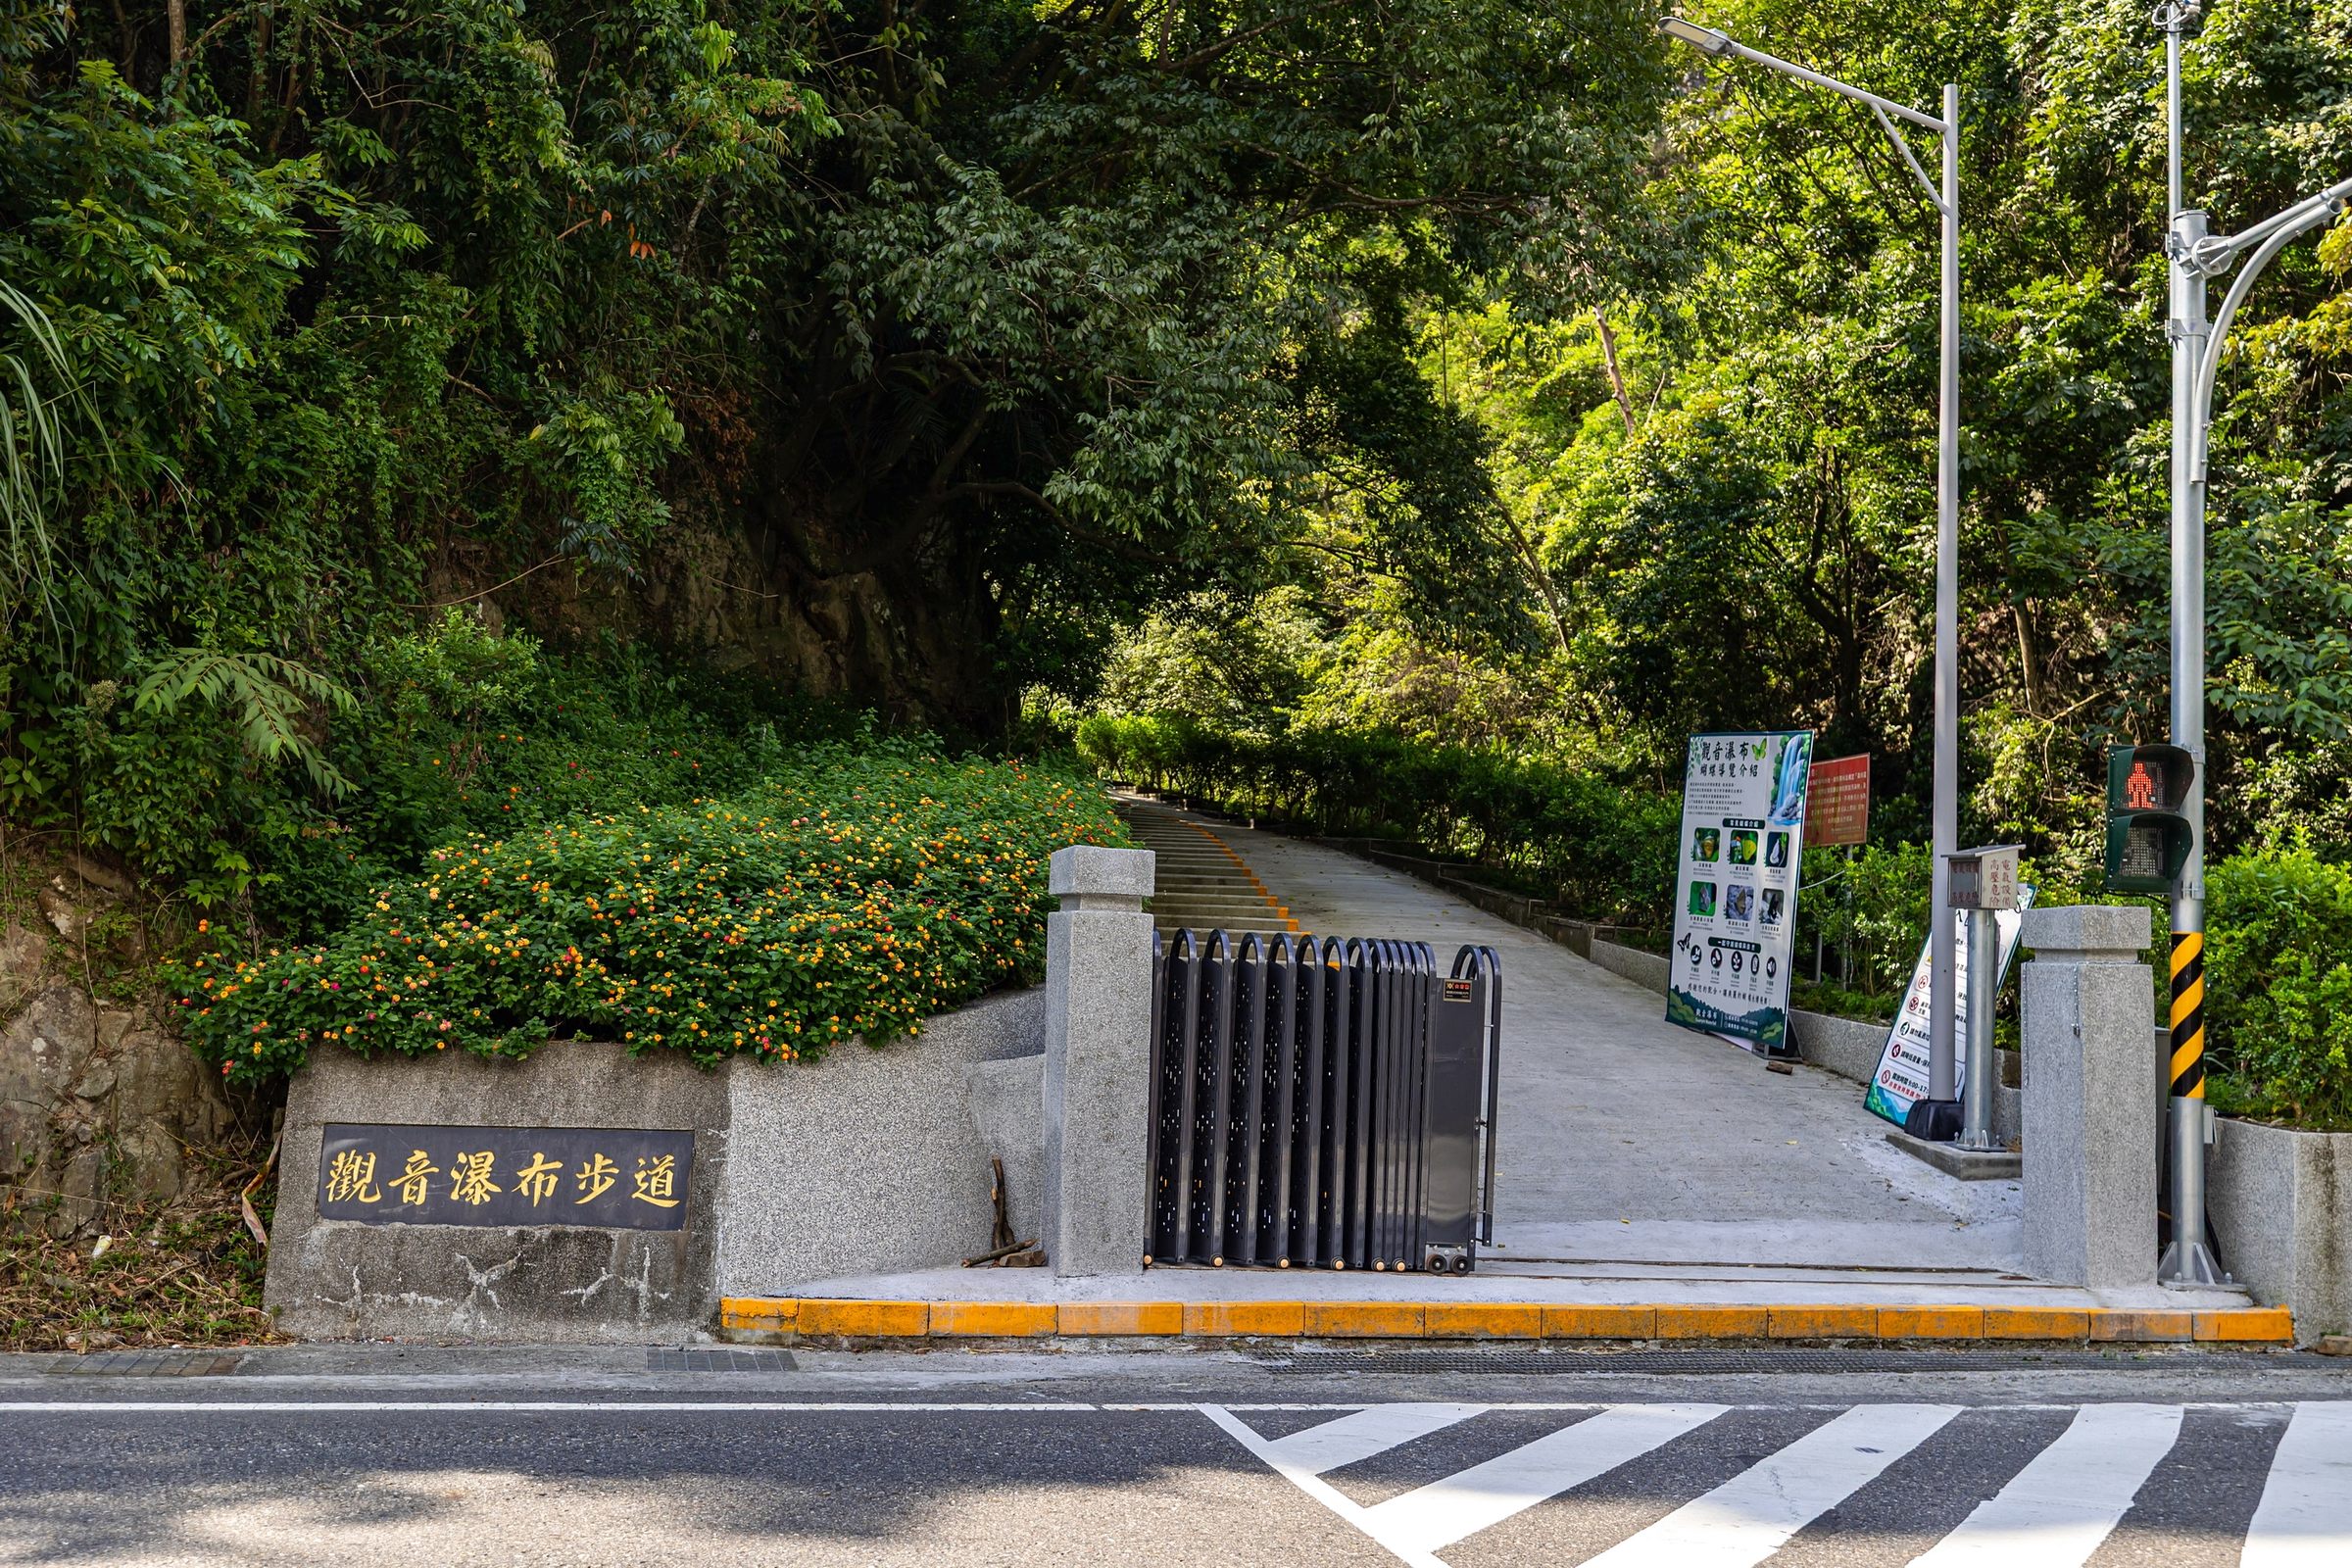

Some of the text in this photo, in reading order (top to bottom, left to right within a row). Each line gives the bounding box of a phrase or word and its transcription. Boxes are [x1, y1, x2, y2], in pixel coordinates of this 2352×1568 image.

[1701, 741, 1749, 760] 觀音瀑布
[1699, 762, 1758, 778] 蝴蝶導覽介紹
[1989, 858, 2000, 907] 高壓危險
[325, 1150, 680, 1207] 觀音瀑布步道
